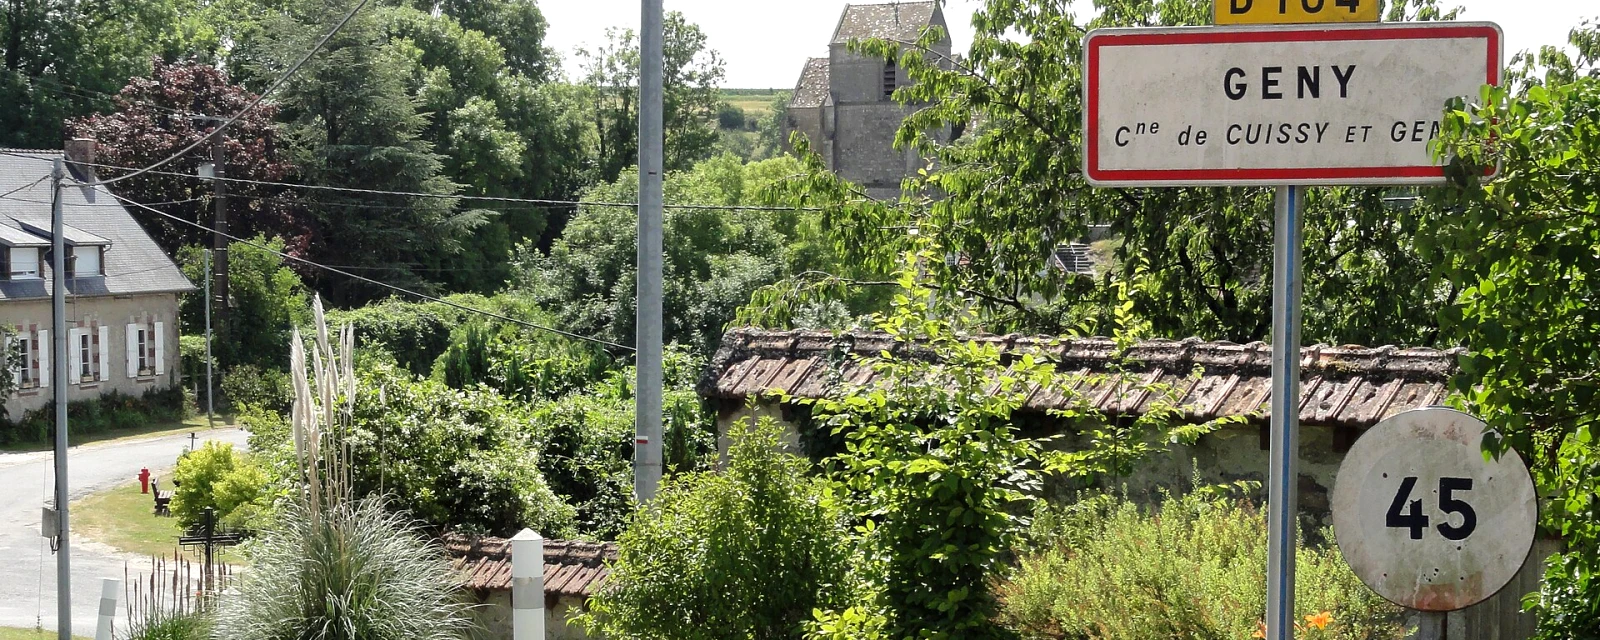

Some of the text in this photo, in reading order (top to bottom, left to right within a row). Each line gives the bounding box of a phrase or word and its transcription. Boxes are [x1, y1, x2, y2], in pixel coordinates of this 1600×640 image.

[1223, 64, 1357, 101] GENY
[1114, 122, 1160, 147] Cne
[1177, 125, 1208, 146] de
[1226, 121, 1329, 145] CUISSY
[1345, 125, 1373, 143] ET
[1385, 476, 1477, 541] 45
